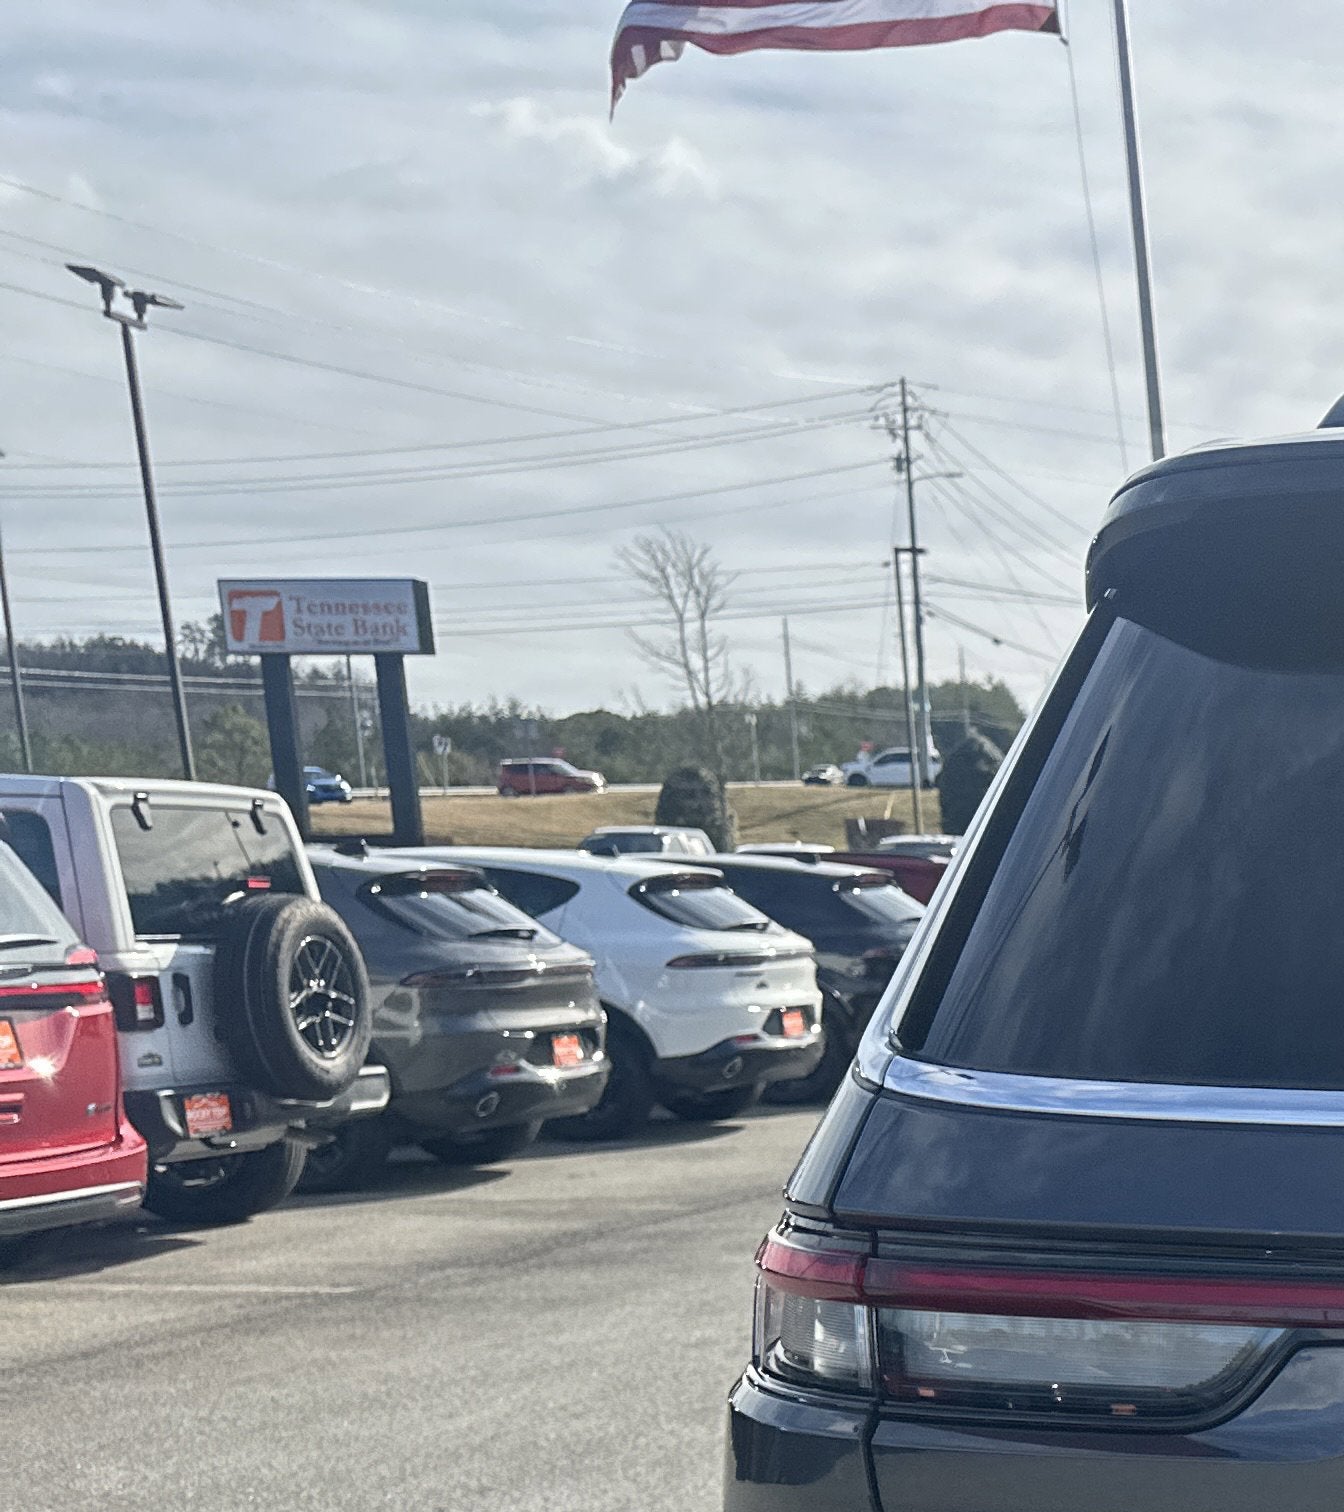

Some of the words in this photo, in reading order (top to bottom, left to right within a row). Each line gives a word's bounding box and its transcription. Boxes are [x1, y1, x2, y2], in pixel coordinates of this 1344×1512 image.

[289, 595, 408, 616] Tennessee
[292, 617, 346, 638] State
[352, 617, 408, 638] Bank
